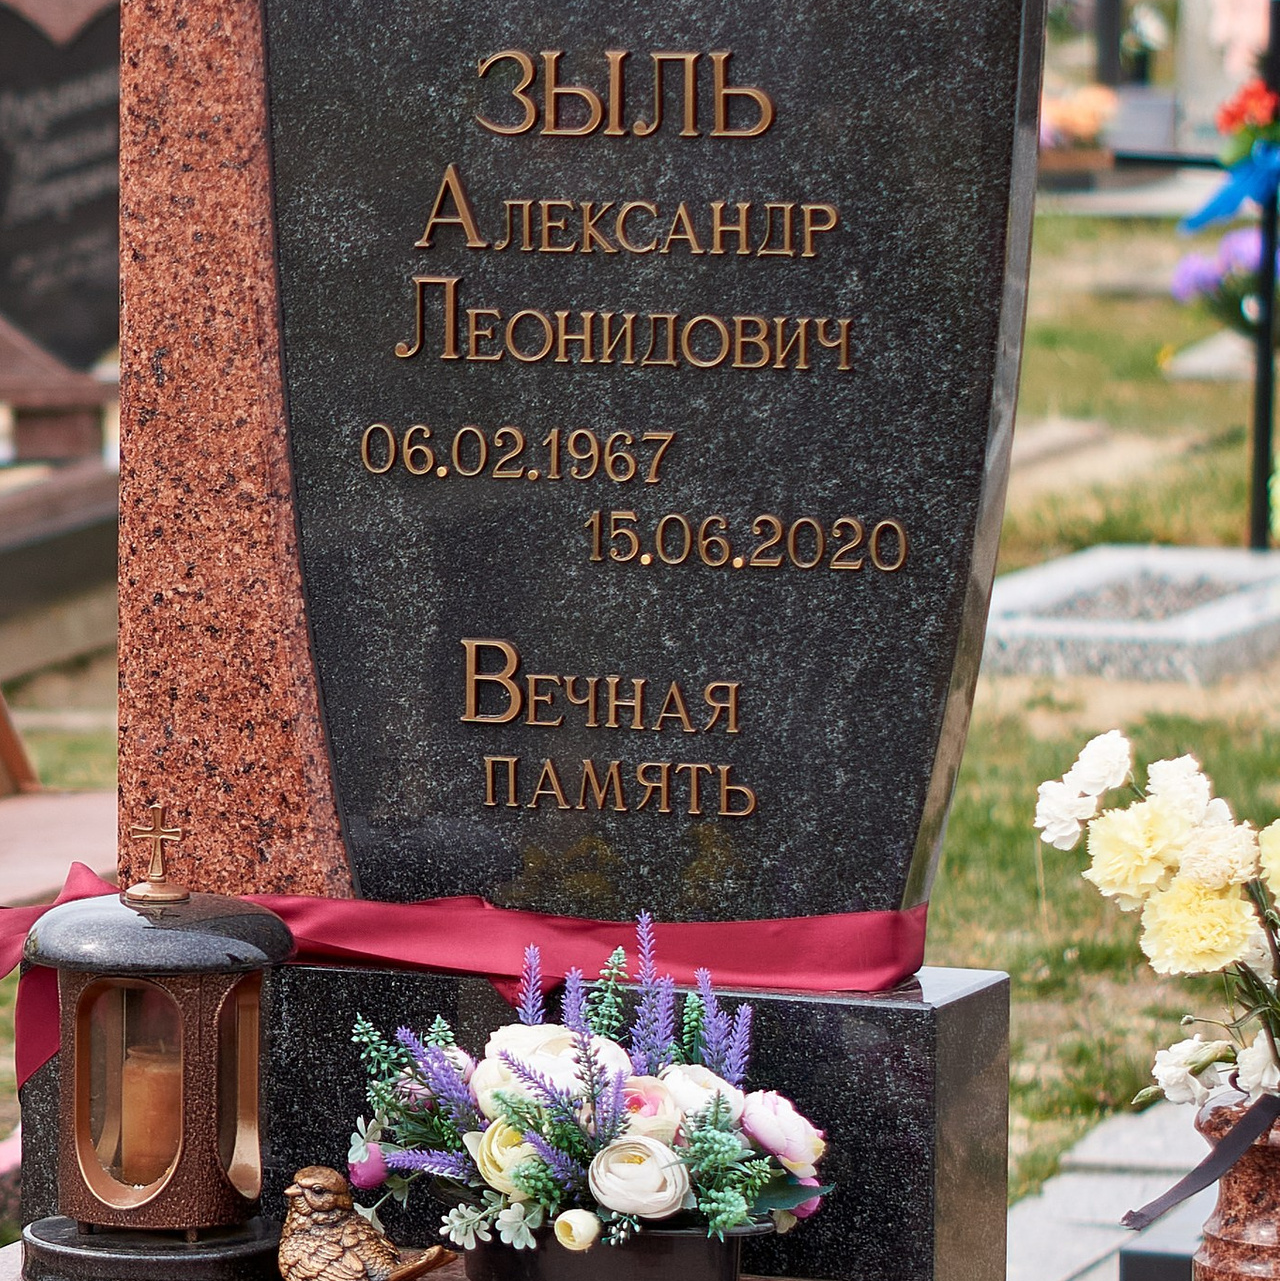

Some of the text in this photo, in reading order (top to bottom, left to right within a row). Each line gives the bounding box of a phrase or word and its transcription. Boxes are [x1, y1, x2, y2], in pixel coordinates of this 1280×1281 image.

[475, 49, 776, 137] ЗЫЛЬ
[361, 423, 677, 484] 06.02.1967
[584, 509, 909, 572] 15.06.2020
[483, 756, 758, 817] ПАМЯТЬ
